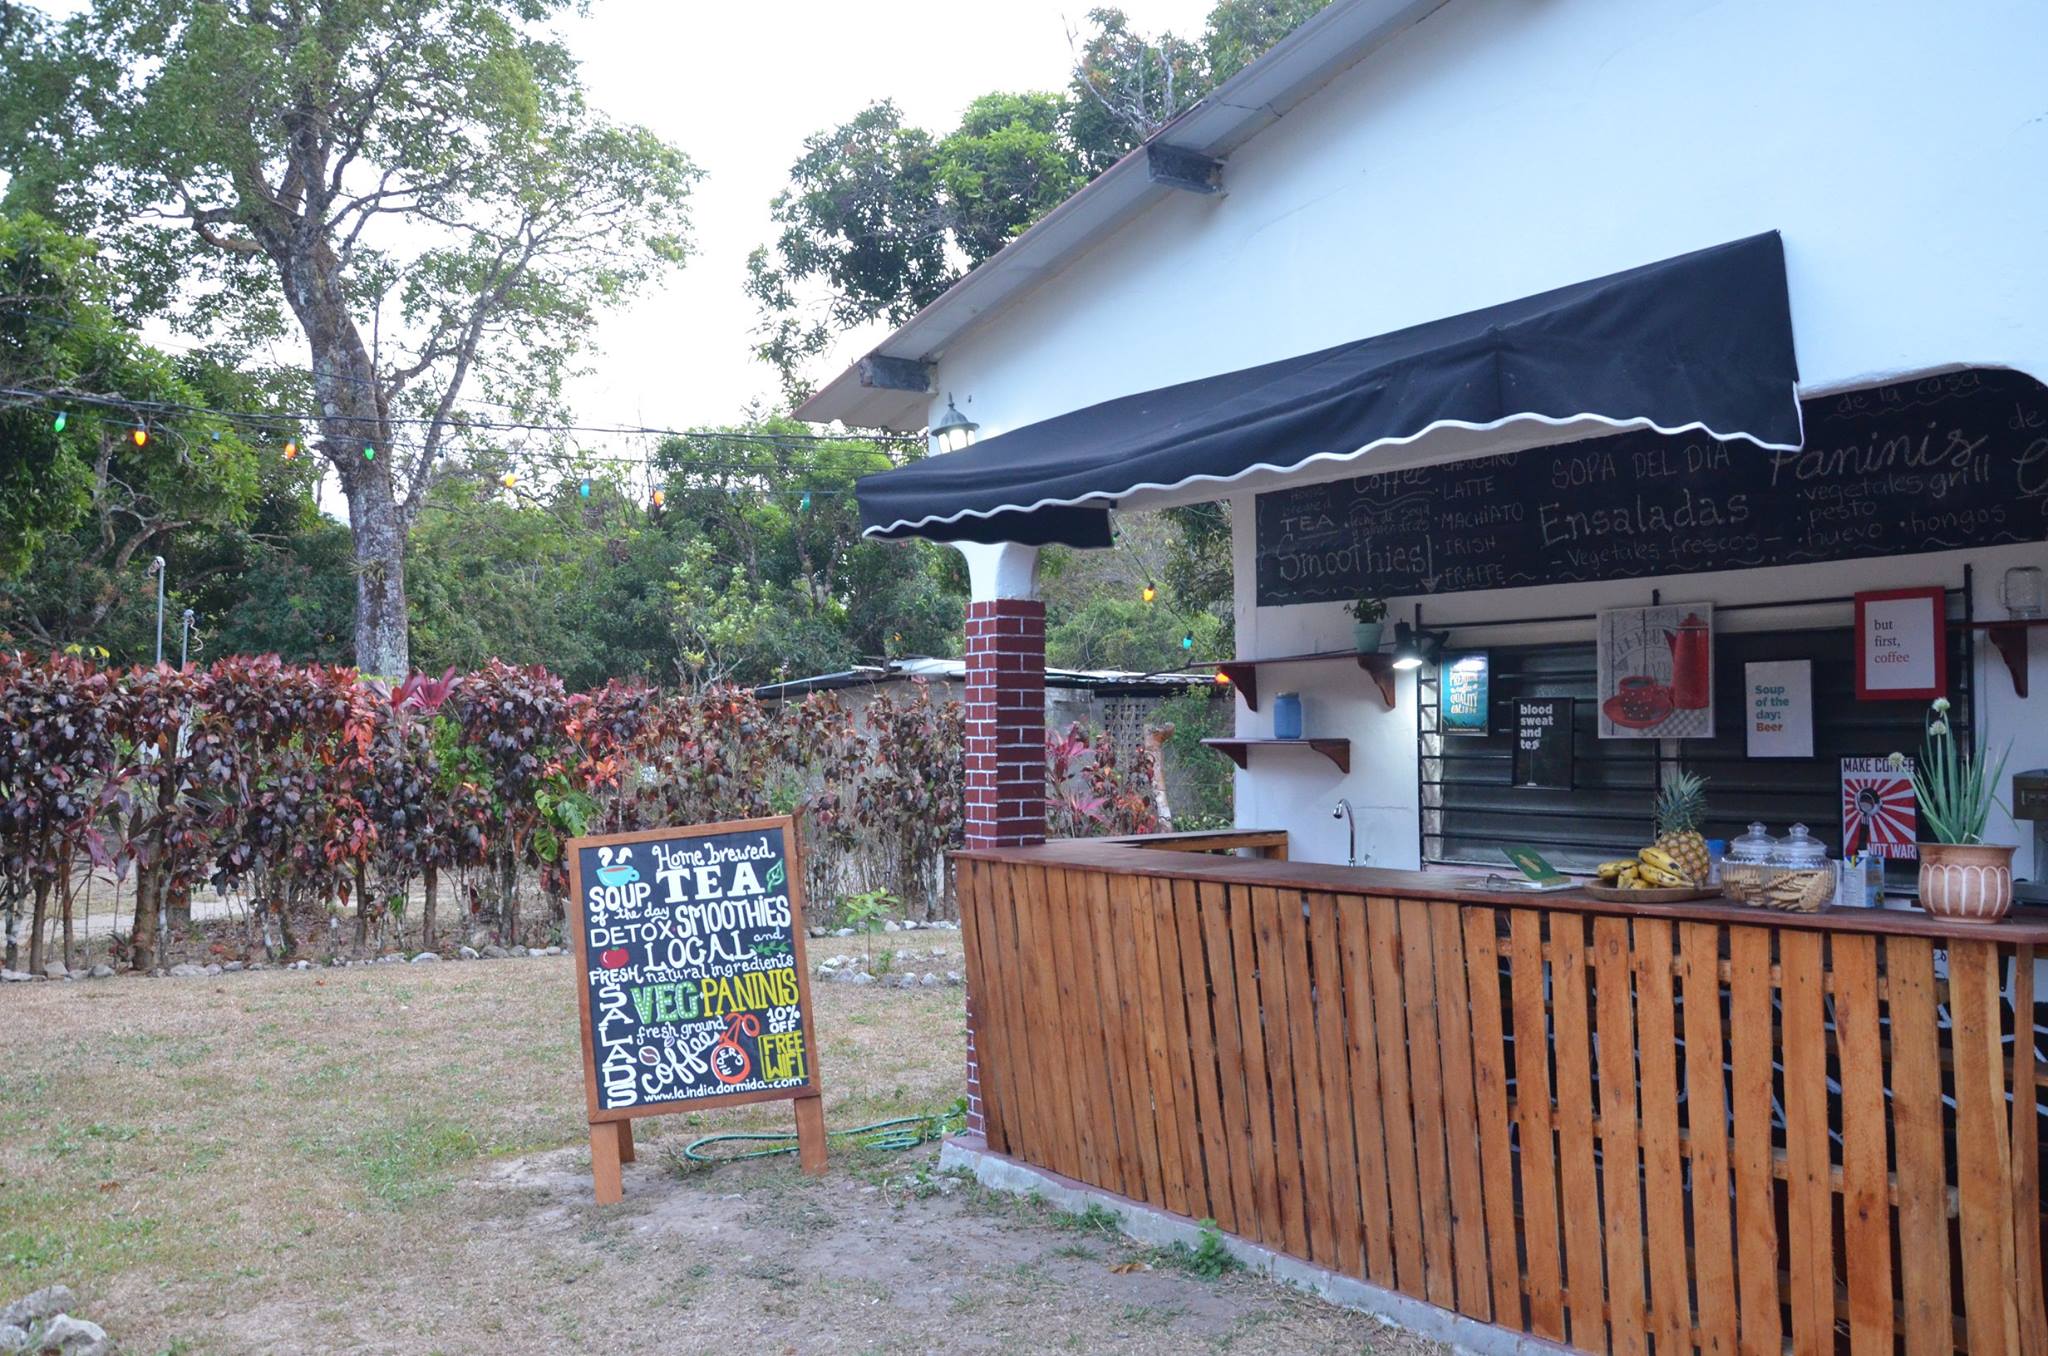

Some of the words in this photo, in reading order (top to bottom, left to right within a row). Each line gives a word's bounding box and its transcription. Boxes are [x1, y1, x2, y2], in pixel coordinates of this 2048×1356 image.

[1552, 452, 1616, 489] SOPA
[1632, 449, 1678, 478] DEL
[1929, 453, 1991, 499] grill
[1443, 476, 1496, 500] LATTE
[1280, 514, 1334, 532] TEA
[1538, 488, 1750, 548] Ensaladas
[1807, 522, 1883, 547] huevo
[1911, 502, 2006, 535] hongos
[1809, 500, 1878, 529] pesto
[1278, 533, 1425, 581] Smoothies
[1444, 535, 1497, 556] IRISH
[1668, 534, 1760, 560] frescos
[1874, 619, 1893, 630] but
[1874, 635, 1900, 648] first,
[1874, 651, 1910, 663] coffee
[1755, 685, 1785, 695] Soup
[1755, 697, 1768, 707] of
[1770, 697, 1790, 707] the
[1520, 704, 1553, 715] blood
[1520, 715, 1554, 726] sweat
[1755, 709, 1782, 720] day:
[1520, 727, 1542, 738] and
[1756, 722, 1783, 732] Beer
[1843, 758, 1871, 773] MAKE
[652, 843, 705, 870] Home
[703, 837, 776, 865] brewed
[656, 862, 766, 903] TEA
[589, 882, 651, 912] SOUP
[591, 910, 609, 927] of
[614, 907, 641, 920] the
[644, 901, 670, 923] day
[590, 920, 675, 948] DETOX
[753, 926, 785, 941] and
[589, 963, 644, 986] FRESH
[645, 964, 710, 983] natural
[711, 952, 794, 978] ingredients
[630, 981, 699, 1024] VEG
[701, 968, 799, 1017] PANINIS
[767, 1005, 800, 1022] 10%
[637, 1021, 679, 1045] fresh
[681, 1015, 728, 1040] ground
[769, 1020, 796, 1033] OFF
[763, 1031, 803, 1057] FREE
[716, 1047, 744, 1075] RIDERS
[765, 1049, 806, 1078] WIFI
[643, 1077, 802, 1102] www.laindiadormida.com
